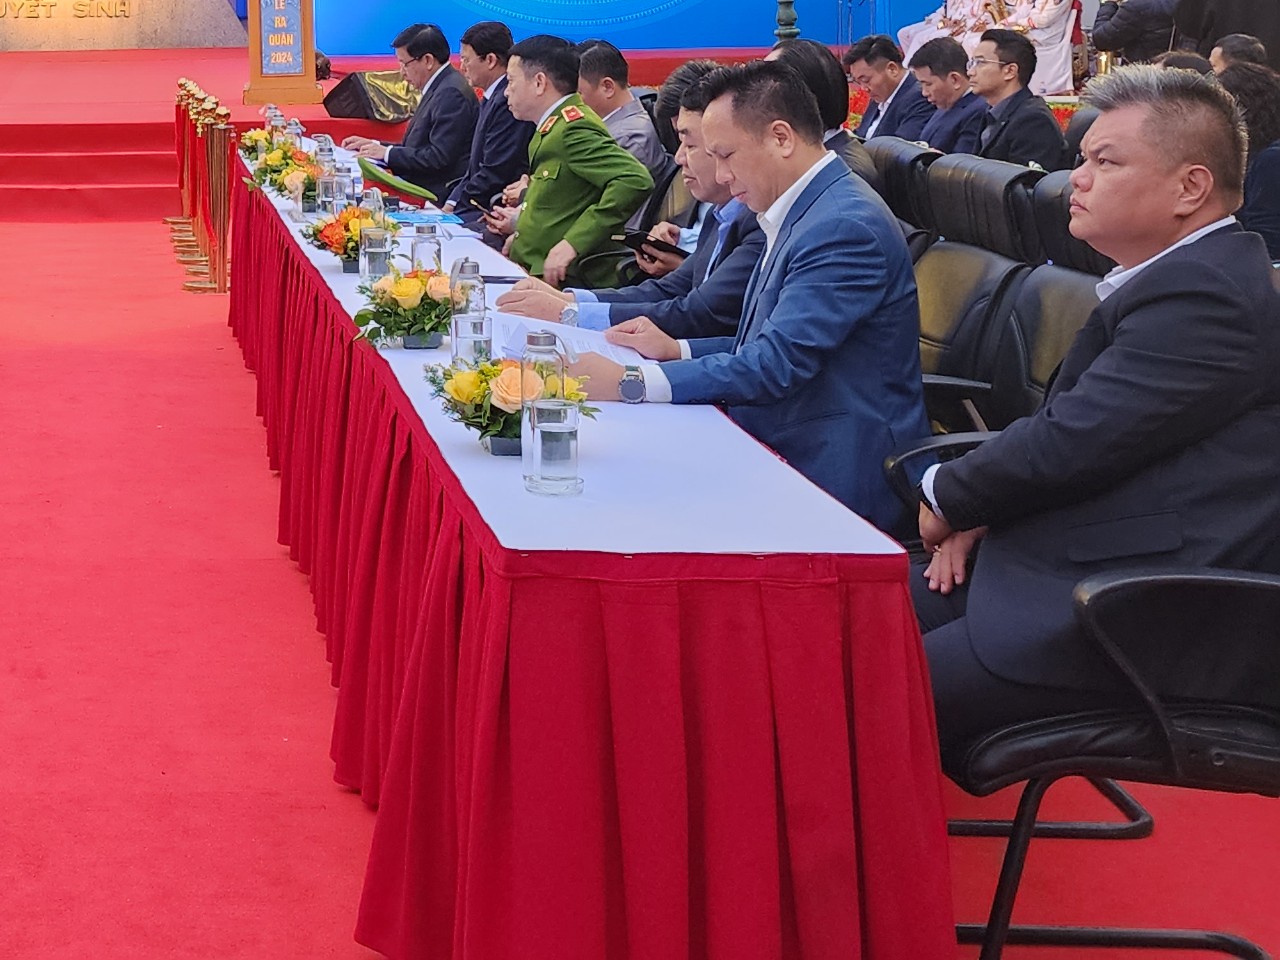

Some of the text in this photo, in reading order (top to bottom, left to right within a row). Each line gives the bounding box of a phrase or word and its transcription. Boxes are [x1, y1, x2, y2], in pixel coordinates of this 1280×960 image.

[275, 16, 287, 28] RA
[269, 32, 294, 45] QUÂN
[271, 52, 292, 64] 2024
